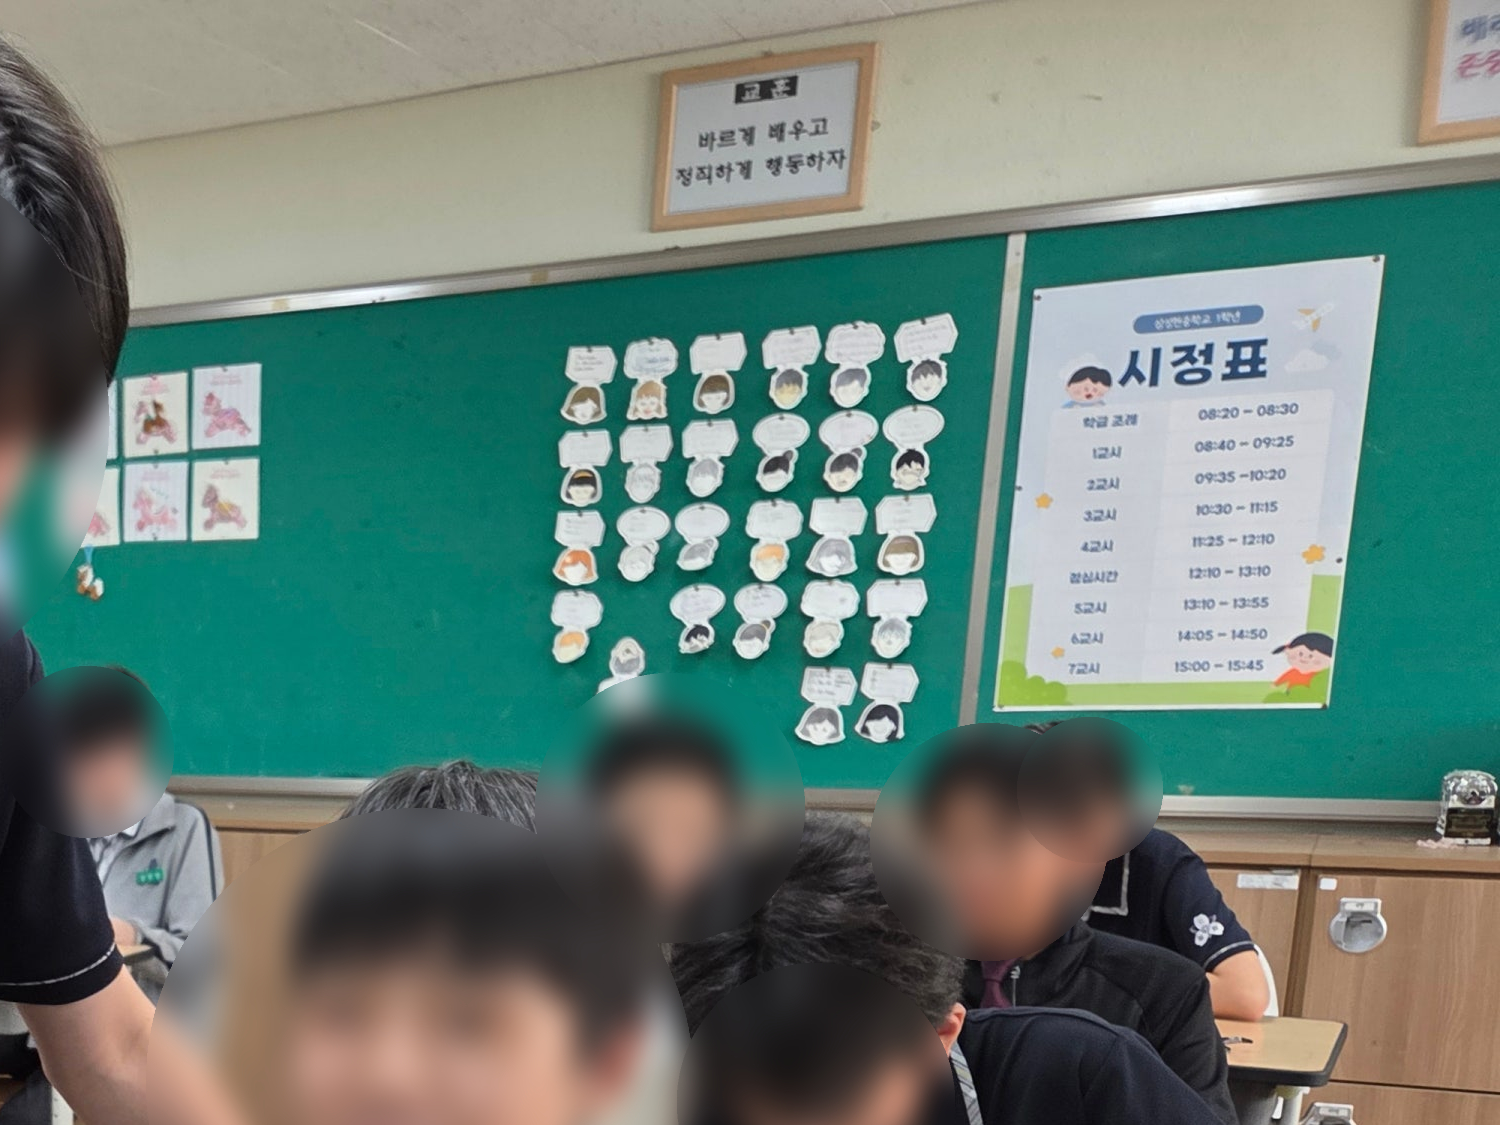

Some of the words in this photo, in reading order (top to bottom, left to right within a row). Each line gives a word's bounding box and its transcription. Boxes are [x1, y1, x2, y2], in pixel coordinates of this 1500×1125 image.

[698, 125, 756, 152] 바르게
[768, 117, 829, 143] 배우고
[675, 159, 753, 187] 정직하게
[765, 148, 847, 178] 행동하자
[1118, 338, 1269, 388] 시정표
[1198, 407, 1240, 421] 08:20
[1257, 402, 1299, 417] 08:30
[1092, 445, 1122, 459] 1교시
[1194, 439, 1236, 453] 08:40
[1253, 435, 1295, 449] 09:25
[1086, 477, 1120, 491] 2교시
[1194, 471, 1236, 485] 09:35
[1083, 508, 1117, 522] 3교시
[1196, 503, 1233, 516] 10:30
[1250, 501, 1278, 514] 11:15
[1081, 539, 1114, 553] 4교시
[1192, 535, 1225, 548] 11:25
[1242, 533, 1275, 546] 12:10
[1069, 570, 1119, 584] 점심시간
[1189, 567, 1221, 580] 12:10
[1238, 565, 1271, 578] 13:10
[1074, 601, 1107, 614] 5교시
[1184, 598, 1216, 611] 13:10
[1233, 596, 1269, 609] 13:55
[1071, 632, 1103, 645] 6교시
[1178, 630, 1214, 642] 14:05
[1231, 628, 1268, 641] 14:50
[1068, 662, 1100, 675] 7교시
[1174, 660, 1210, 673] 15:00
[1228, 659, 1264, 672] 15:45
